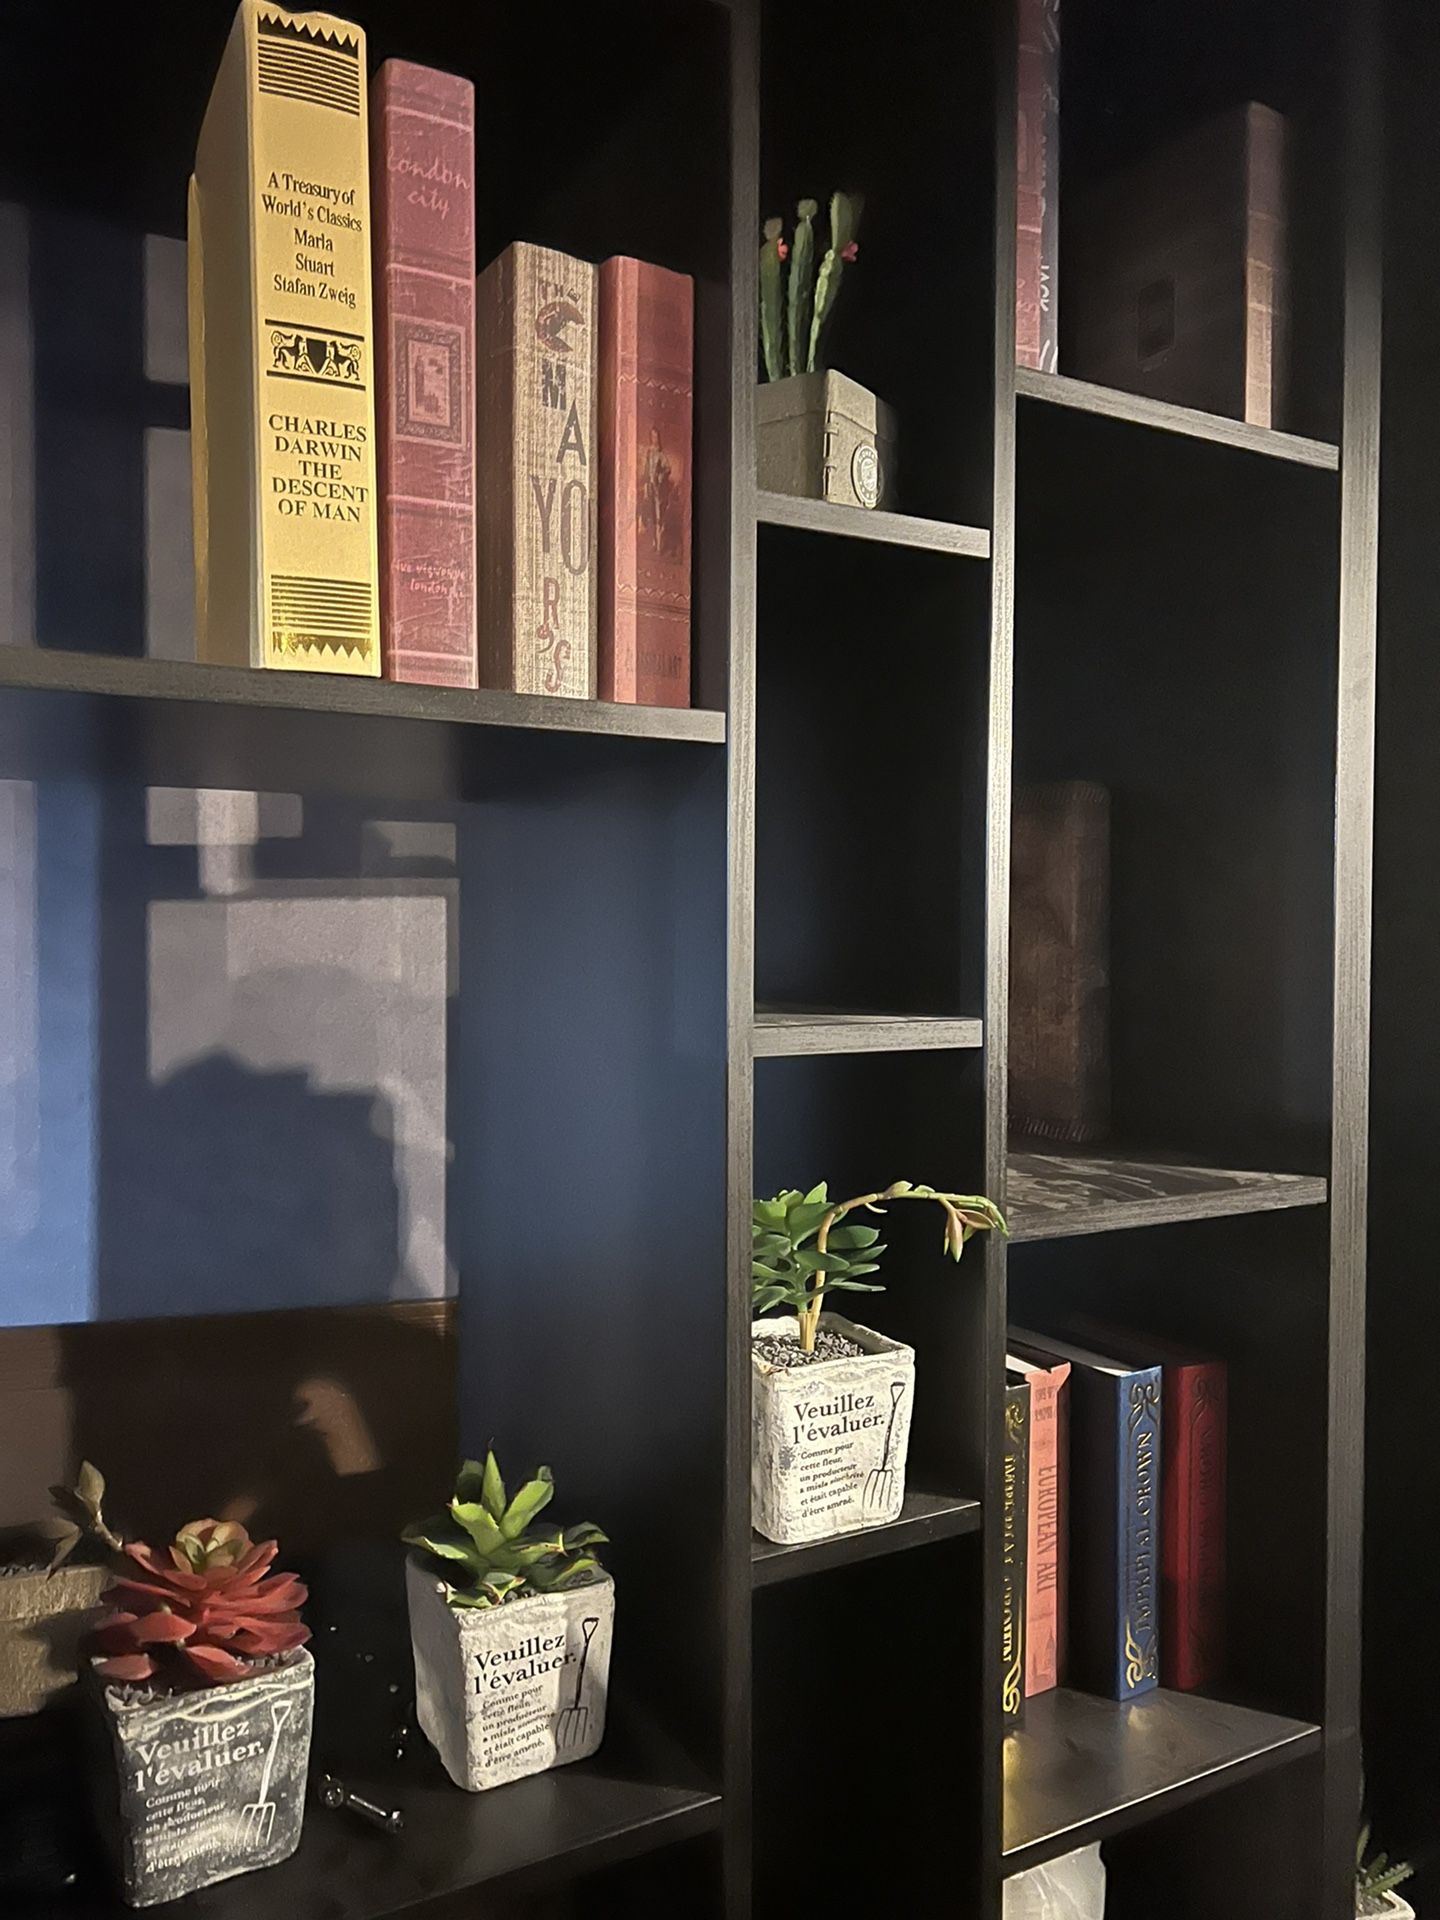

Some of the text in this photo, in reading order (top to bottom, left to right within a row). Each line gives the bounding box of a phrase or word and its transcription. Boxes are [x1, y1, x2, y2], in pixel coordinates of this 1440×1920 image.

[266, 171, 355, 206] A Treasury of
[407, 185, 449, 220] city
[316, 205, 362, 232] Classics
[295, 252, 335, 278] Stuart
[273, 274, 357, 310] Stafan Zweig
[268, 413, 367, 443] CHARLES
[274, 435, 361, 462] DARWIN
[298, 459, 343, 480] THE
[271, 476, 369, 503] DESCENT
[278, 498, 360, 522] OF MAN
[793, 1393, 875, 1422] Veuillez
[793, 1414, 885, 1445] l'évaluer.
[800, 1442, 855, 1460] Comme pour
[800, 1462, 820, 1471] cette
[800, 1474, 811, 1482] un
[1137, 1431, 1153, 1517] CROWN
[800, 1498, 808, 1506] et
[828, 1482, 858, 1497] capable
[474, 1635, 565, 1672] Veuillez
[474, 1652, 577, 1695] l'évaluer.
[482, 1685, 543, 1709] Comme pour
[482, 1724, 494, 1732] un
[483, 1747, 492, 1756] et
[516, 1724, 550, 1742] capable
[135, 1720, 250, 1766] Veuillez
[134, 1741, 264, 1793] l'évaluer.
[145, 1788, 192, 1808] Comme
